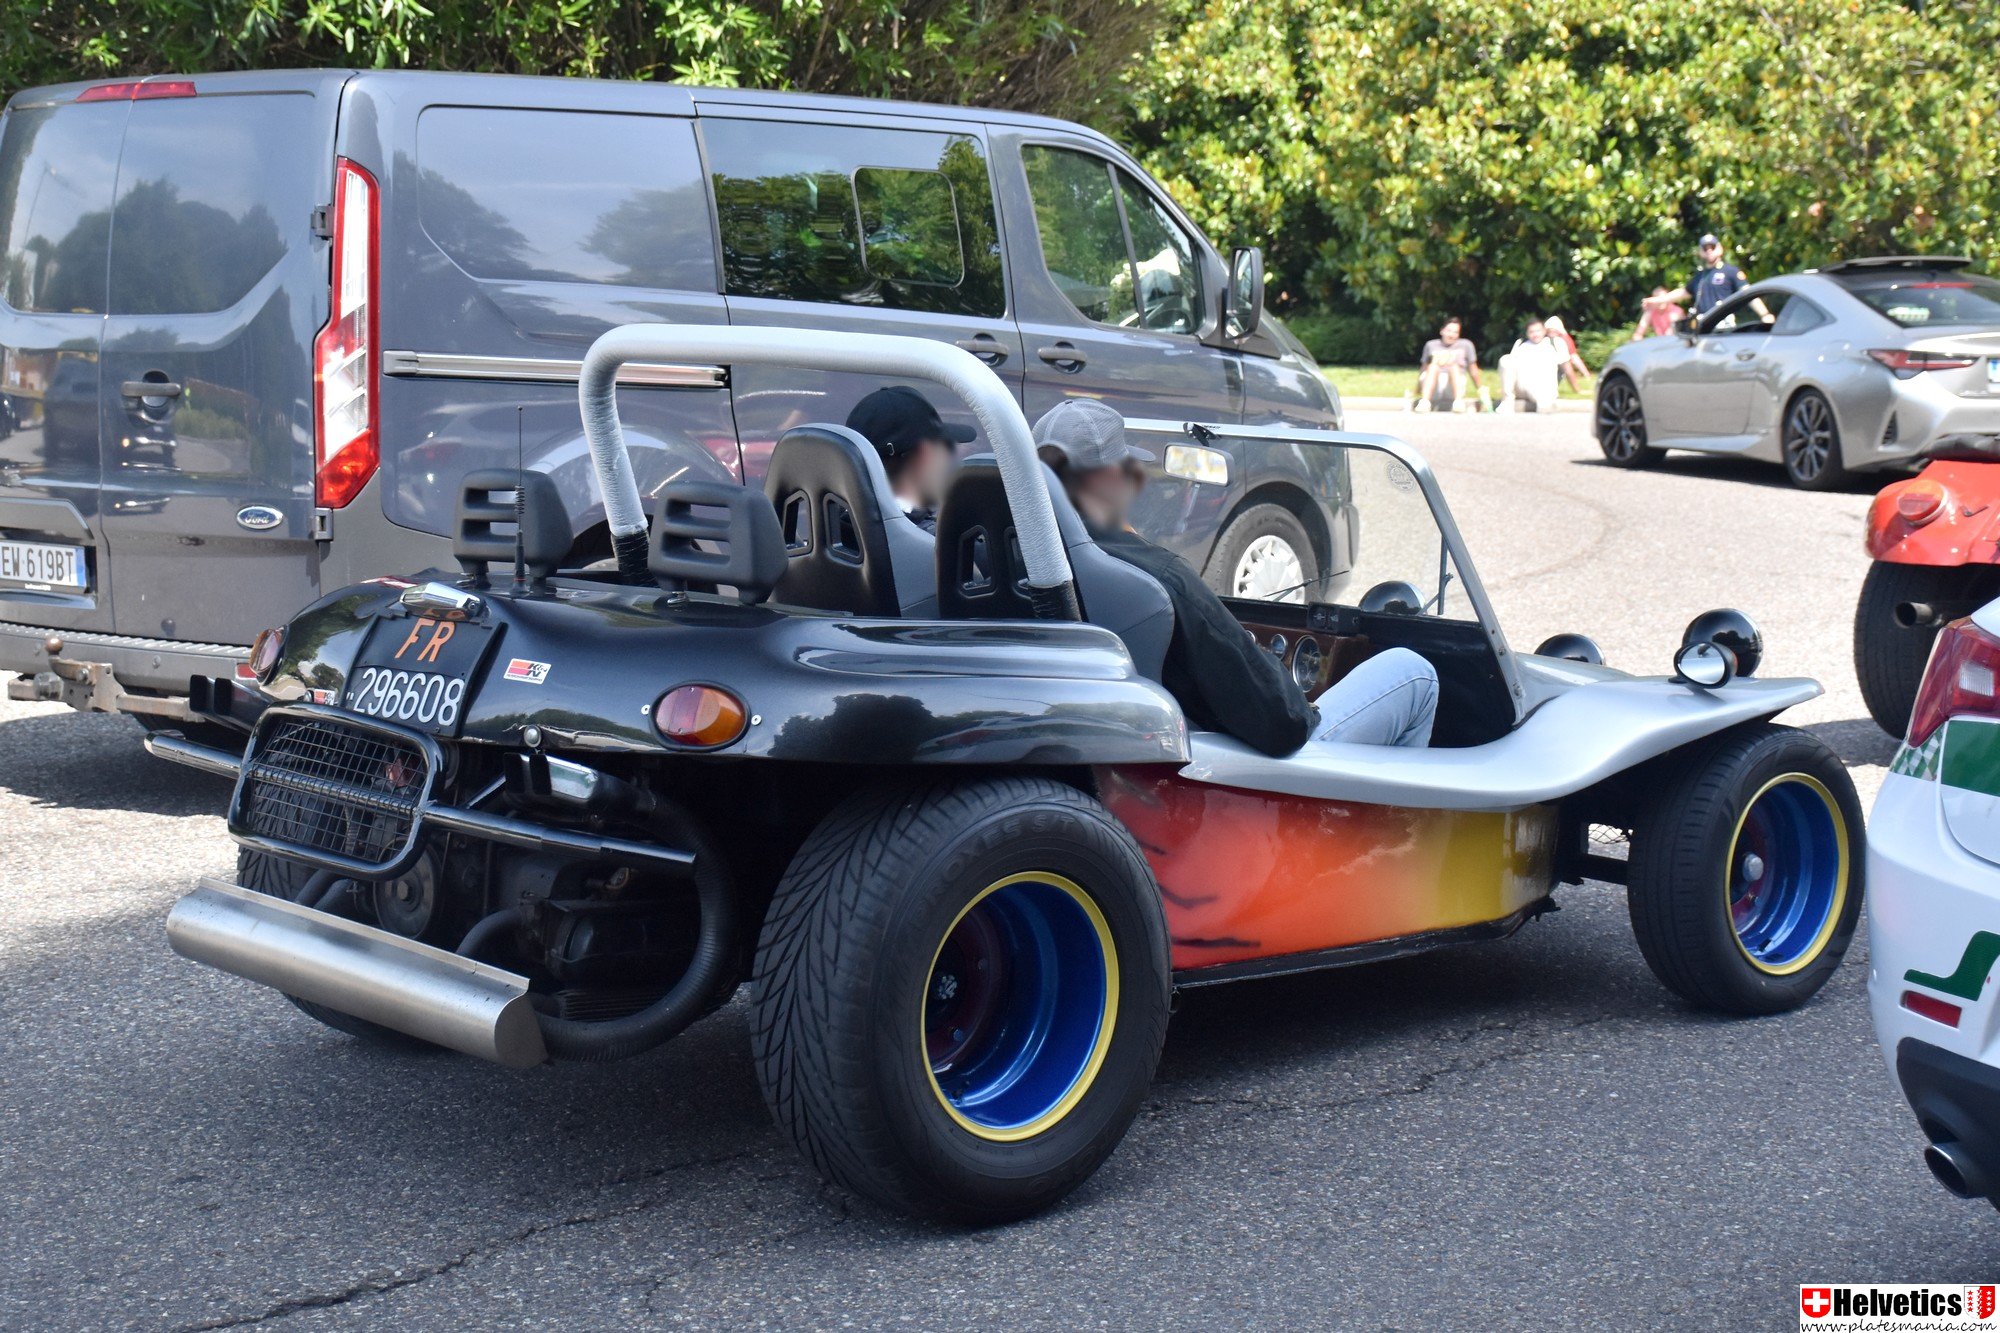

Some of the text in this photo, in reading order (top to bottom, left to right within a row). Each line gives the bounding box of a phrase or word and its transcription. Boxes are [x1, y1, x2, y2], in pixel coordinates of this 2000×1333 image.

[243, 510, 269, 523] Ford
[2, 546, 74, 583] EW 619BT
[394, 617, 456, 663] FR
[353, 667, 465, 727] 296608
